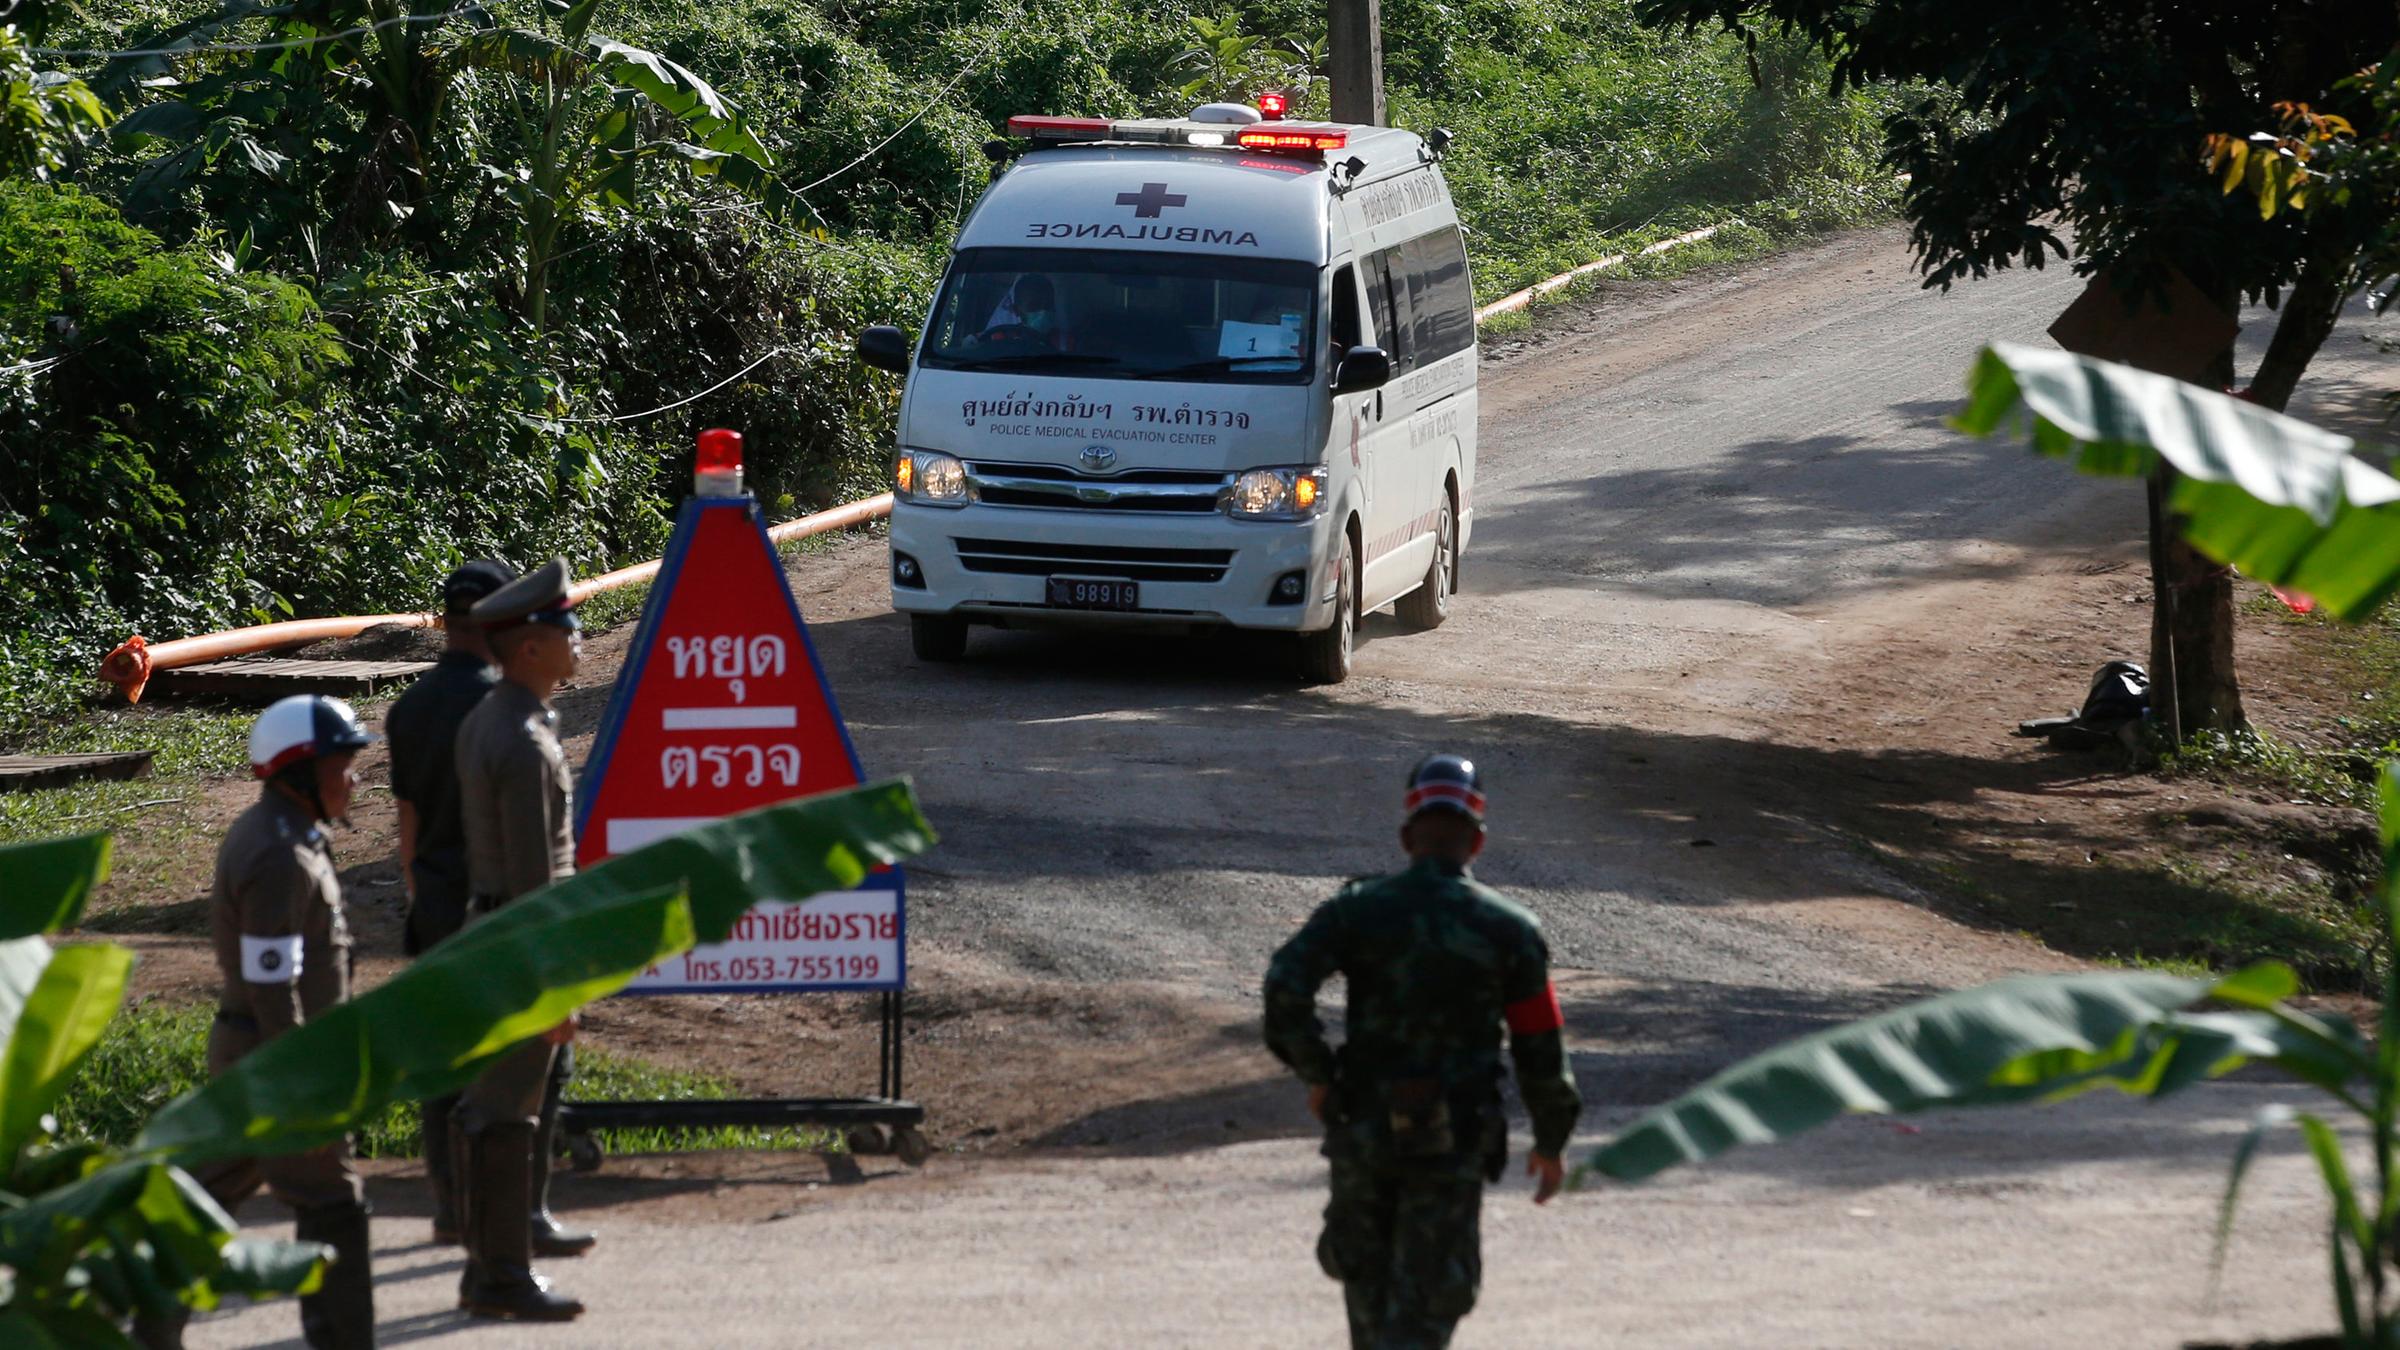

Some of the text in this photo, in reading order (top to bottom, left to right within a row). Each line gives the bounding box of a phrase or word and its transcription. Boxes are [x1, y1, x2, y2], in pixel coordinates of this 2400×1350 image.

[1247, 337, 1257, 352] 1
[961, 390, 1250, 430] ศูนย์ส่งกลับฯ รพ.ตำรวจ
[990, 424, 1217, 446] POLICE MEDICAL EVACUATION CENTER
[1076, 584, 1135, 603] 98919
[666, 634, 786, 704] หยุด
[661, 744, 800, 788] ตรวจ
